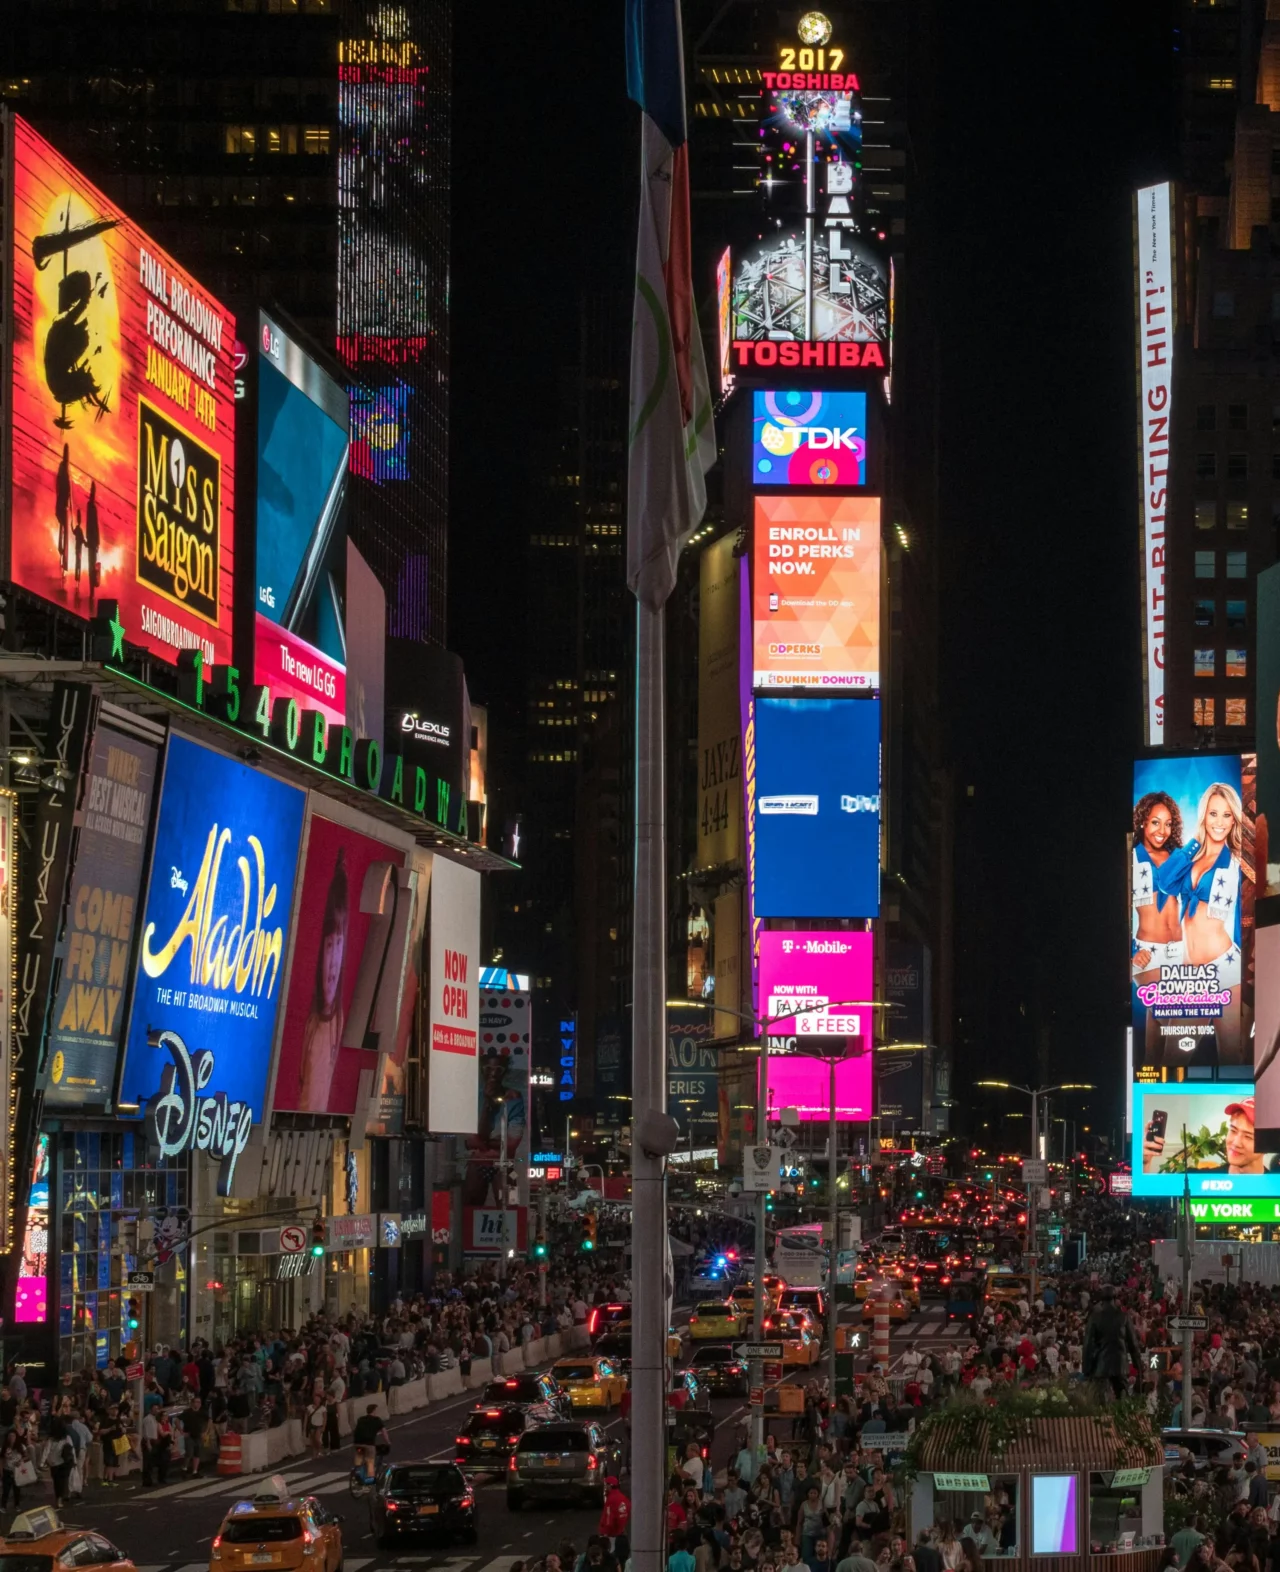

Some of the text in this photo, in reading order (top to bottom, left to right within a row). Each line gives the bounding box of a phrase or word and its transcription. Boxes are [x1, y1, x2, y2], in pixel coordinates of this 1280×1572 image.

[780, 49, 844, 70] 2017
[763, 72, 860, 90] TOSHIBA
[824, 162, 854, 294] BALL
[139, 247, 223, 351] FINAL BROADWAY
[147, 299, 217, 390] PERFORMANCE
[733, 341, 885, 367] TOSHIBA
[145, 345, 216, 433] JANUARY 14TH
[783, 427, 859, 449] TDK
[143, 491, 215, 600] Saigon
[769, 528, 861, 541] ENROLL IN
[769, 545, 855, 558] DD PERKS
[769, 562, 816, 575] NOW.
[280, 644, 336, 699] The new LG G6
[822, 676, 866, 685] DONUTS
[416, 719, 450, 737] LEXUS
[313, 711, 484, 843] BROADWA
[74, 884, 134, 941] COME
[142, 823, 282, 999] Aladdin
[66, 931, 128, 988] FROM
[445, 949, 468, 984] NOW
[1161, 965, 1216, 980] DALLAS
[774, 986, 818, 994] NOW WITH
[1137, 982, 1231, 1006] Cheerleaders
[1158, 981, 1219, 994] COWBOYS
[58, 983, 122, 1036] AWAY
[157, 987, 259, 1020] THE HIT BROADWAY MUSICAL
[443, 984, 468, 1019] OPEN
[801, 1019, 856, 1033] & FEES
[1160, 1026, 1197, 1036] THURSDAYS
[669, 1081, 706, 1095] ERIES
[155, 1030, 252, 1196] Disney
[1201, 1180, 1233, 1191] #EXO
[1211, 1204, 1253, 1217] YORK
